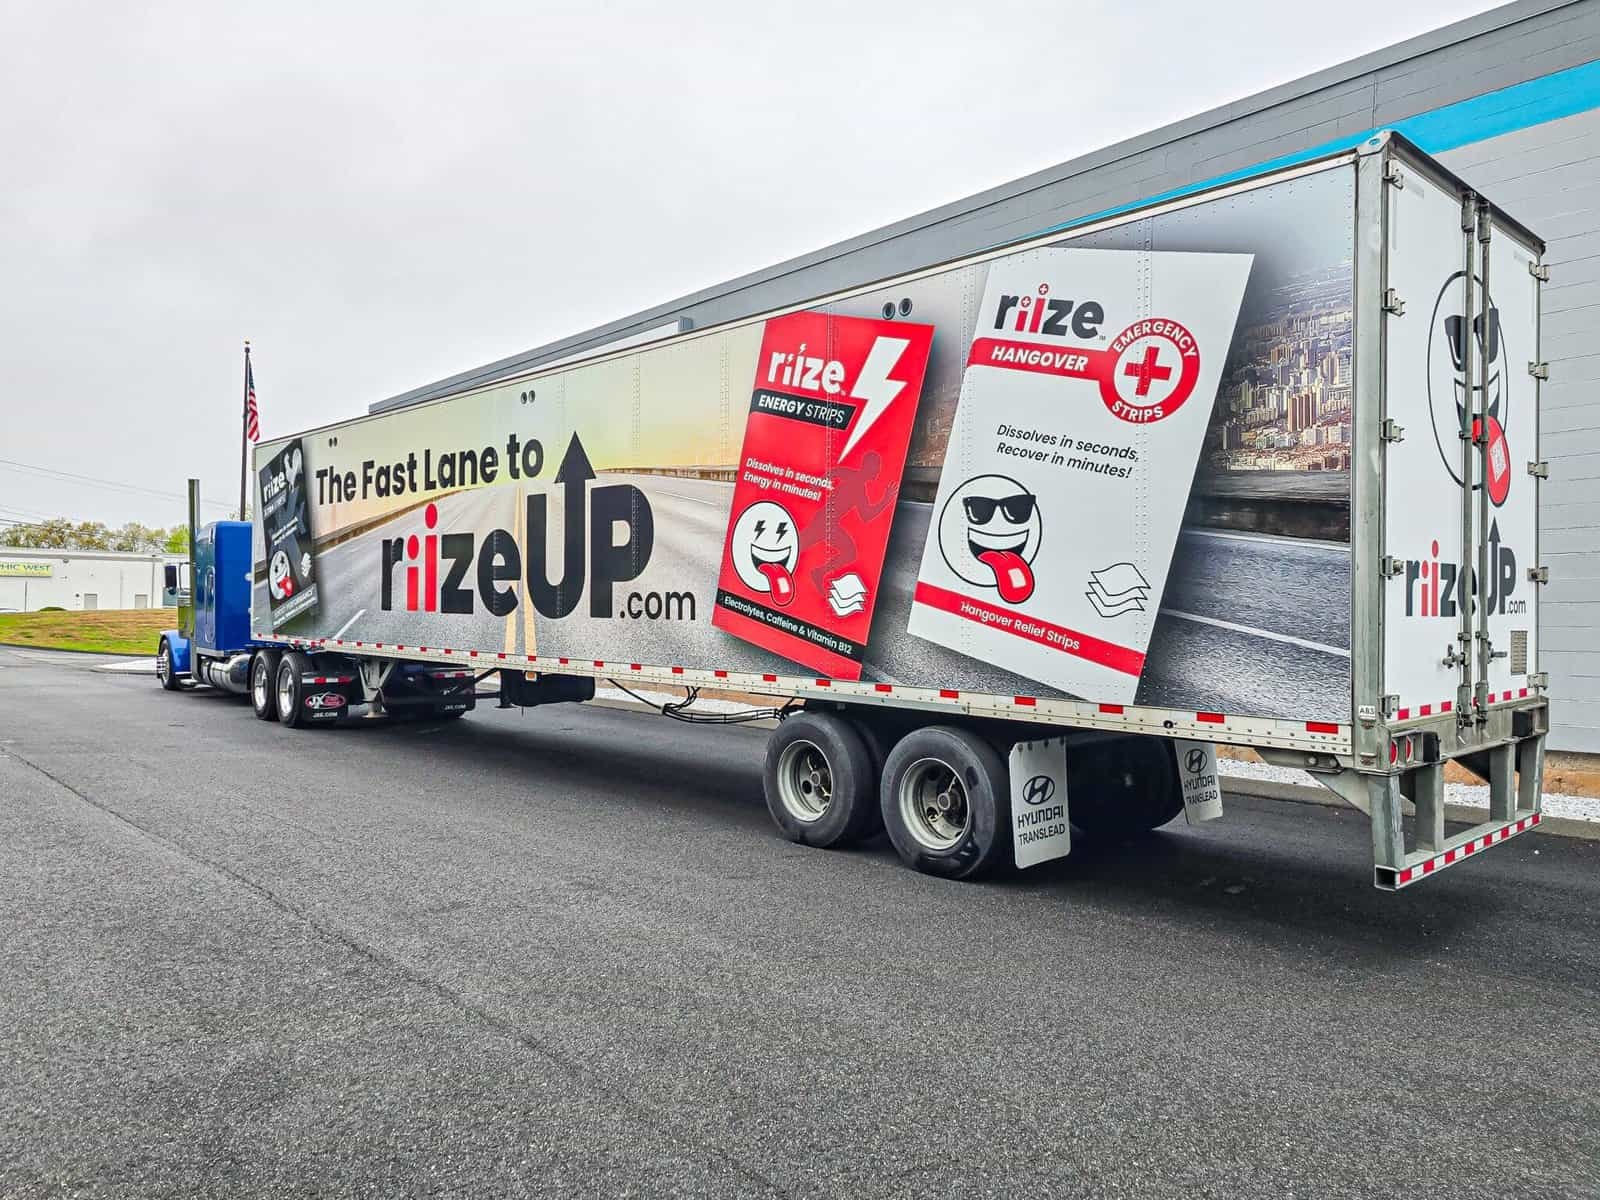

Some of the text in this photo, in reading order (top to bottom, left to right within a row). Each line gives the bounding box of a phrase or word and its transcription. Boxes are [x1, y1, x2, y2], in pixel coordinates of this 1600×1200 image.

[994, 283, 1105, 339] riize
[1113, 320, 1198, 357] EMERGENCY
[768, 343, 845, 394] riize
[991, 346, 1089, 372] HANGOVER
[758, 395, 845, 423] ENERGY STRIPS
[1111, 400, 1164, 421] STRIPS
[997, 424, 1139, 463] Dissolves in seconds,
[997, 442, 1133, 479] Recover in minutes!
[316, 466, 356, 505] The
[362, 452, 417, 499] Fast
[424, 446, 498, 490] Lane
[506, 434, 544, 479] to
[746, 458, 784, 477] Dissolves
[785, 467, 794, 479] in
[743, 471, 821, 502] Energy in minutes!
[724, 596, 853, 655] Electrolytes, Caffeine & Vitamin B12
[960, 602, 1080, 650] Hangover Relief Strips
[1183, 775, 1216, 792] HYUNDAI
[1018, 805, 1064, 829] HYUNDAI
[1018, 823, 1066, 846] TRANSLEAD
